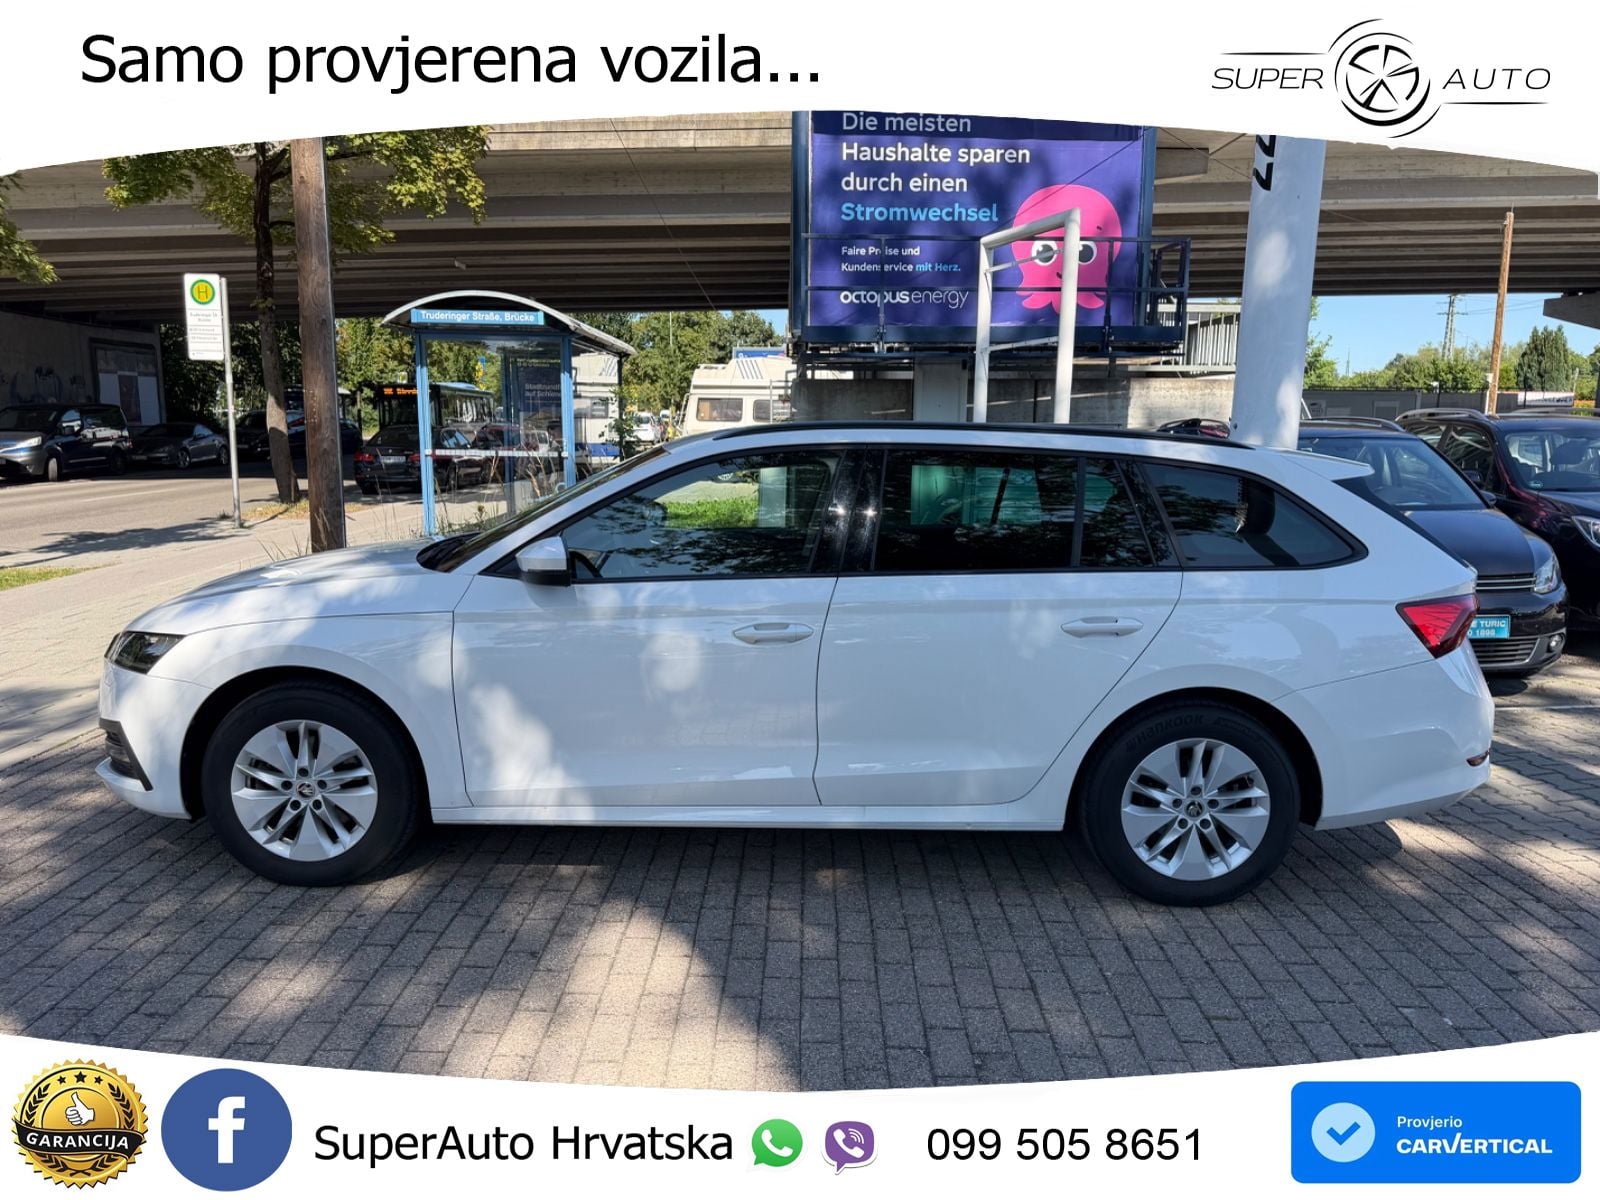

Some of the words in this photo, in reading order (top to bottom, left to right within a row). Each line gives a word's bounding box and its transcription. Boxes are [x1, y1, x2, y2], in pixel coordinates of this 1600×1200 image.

[842, 112, 878, 131] Die
[884, 112, 972, 132] meisten
[841, 142, 952, 162] Haushalte
[957, 148, 1031, 167] sparen
[841, 172, 903, 192] durch
[909, 173, 968, 192] einen
[840, 202, 999, 222] Stromwechsel
[841, 246, 867, 256] Faire
[901, 246, 921, 256] und
[915, 262, 933, 272] mit
[934, 262, 961, 272] Herz.
[197, 285, 209, 300] H
[420, 310, 470, 322] Truderinger
[504, 312, 535, 322] Brücke
[1479, 619, 1506, 628] TURIC
